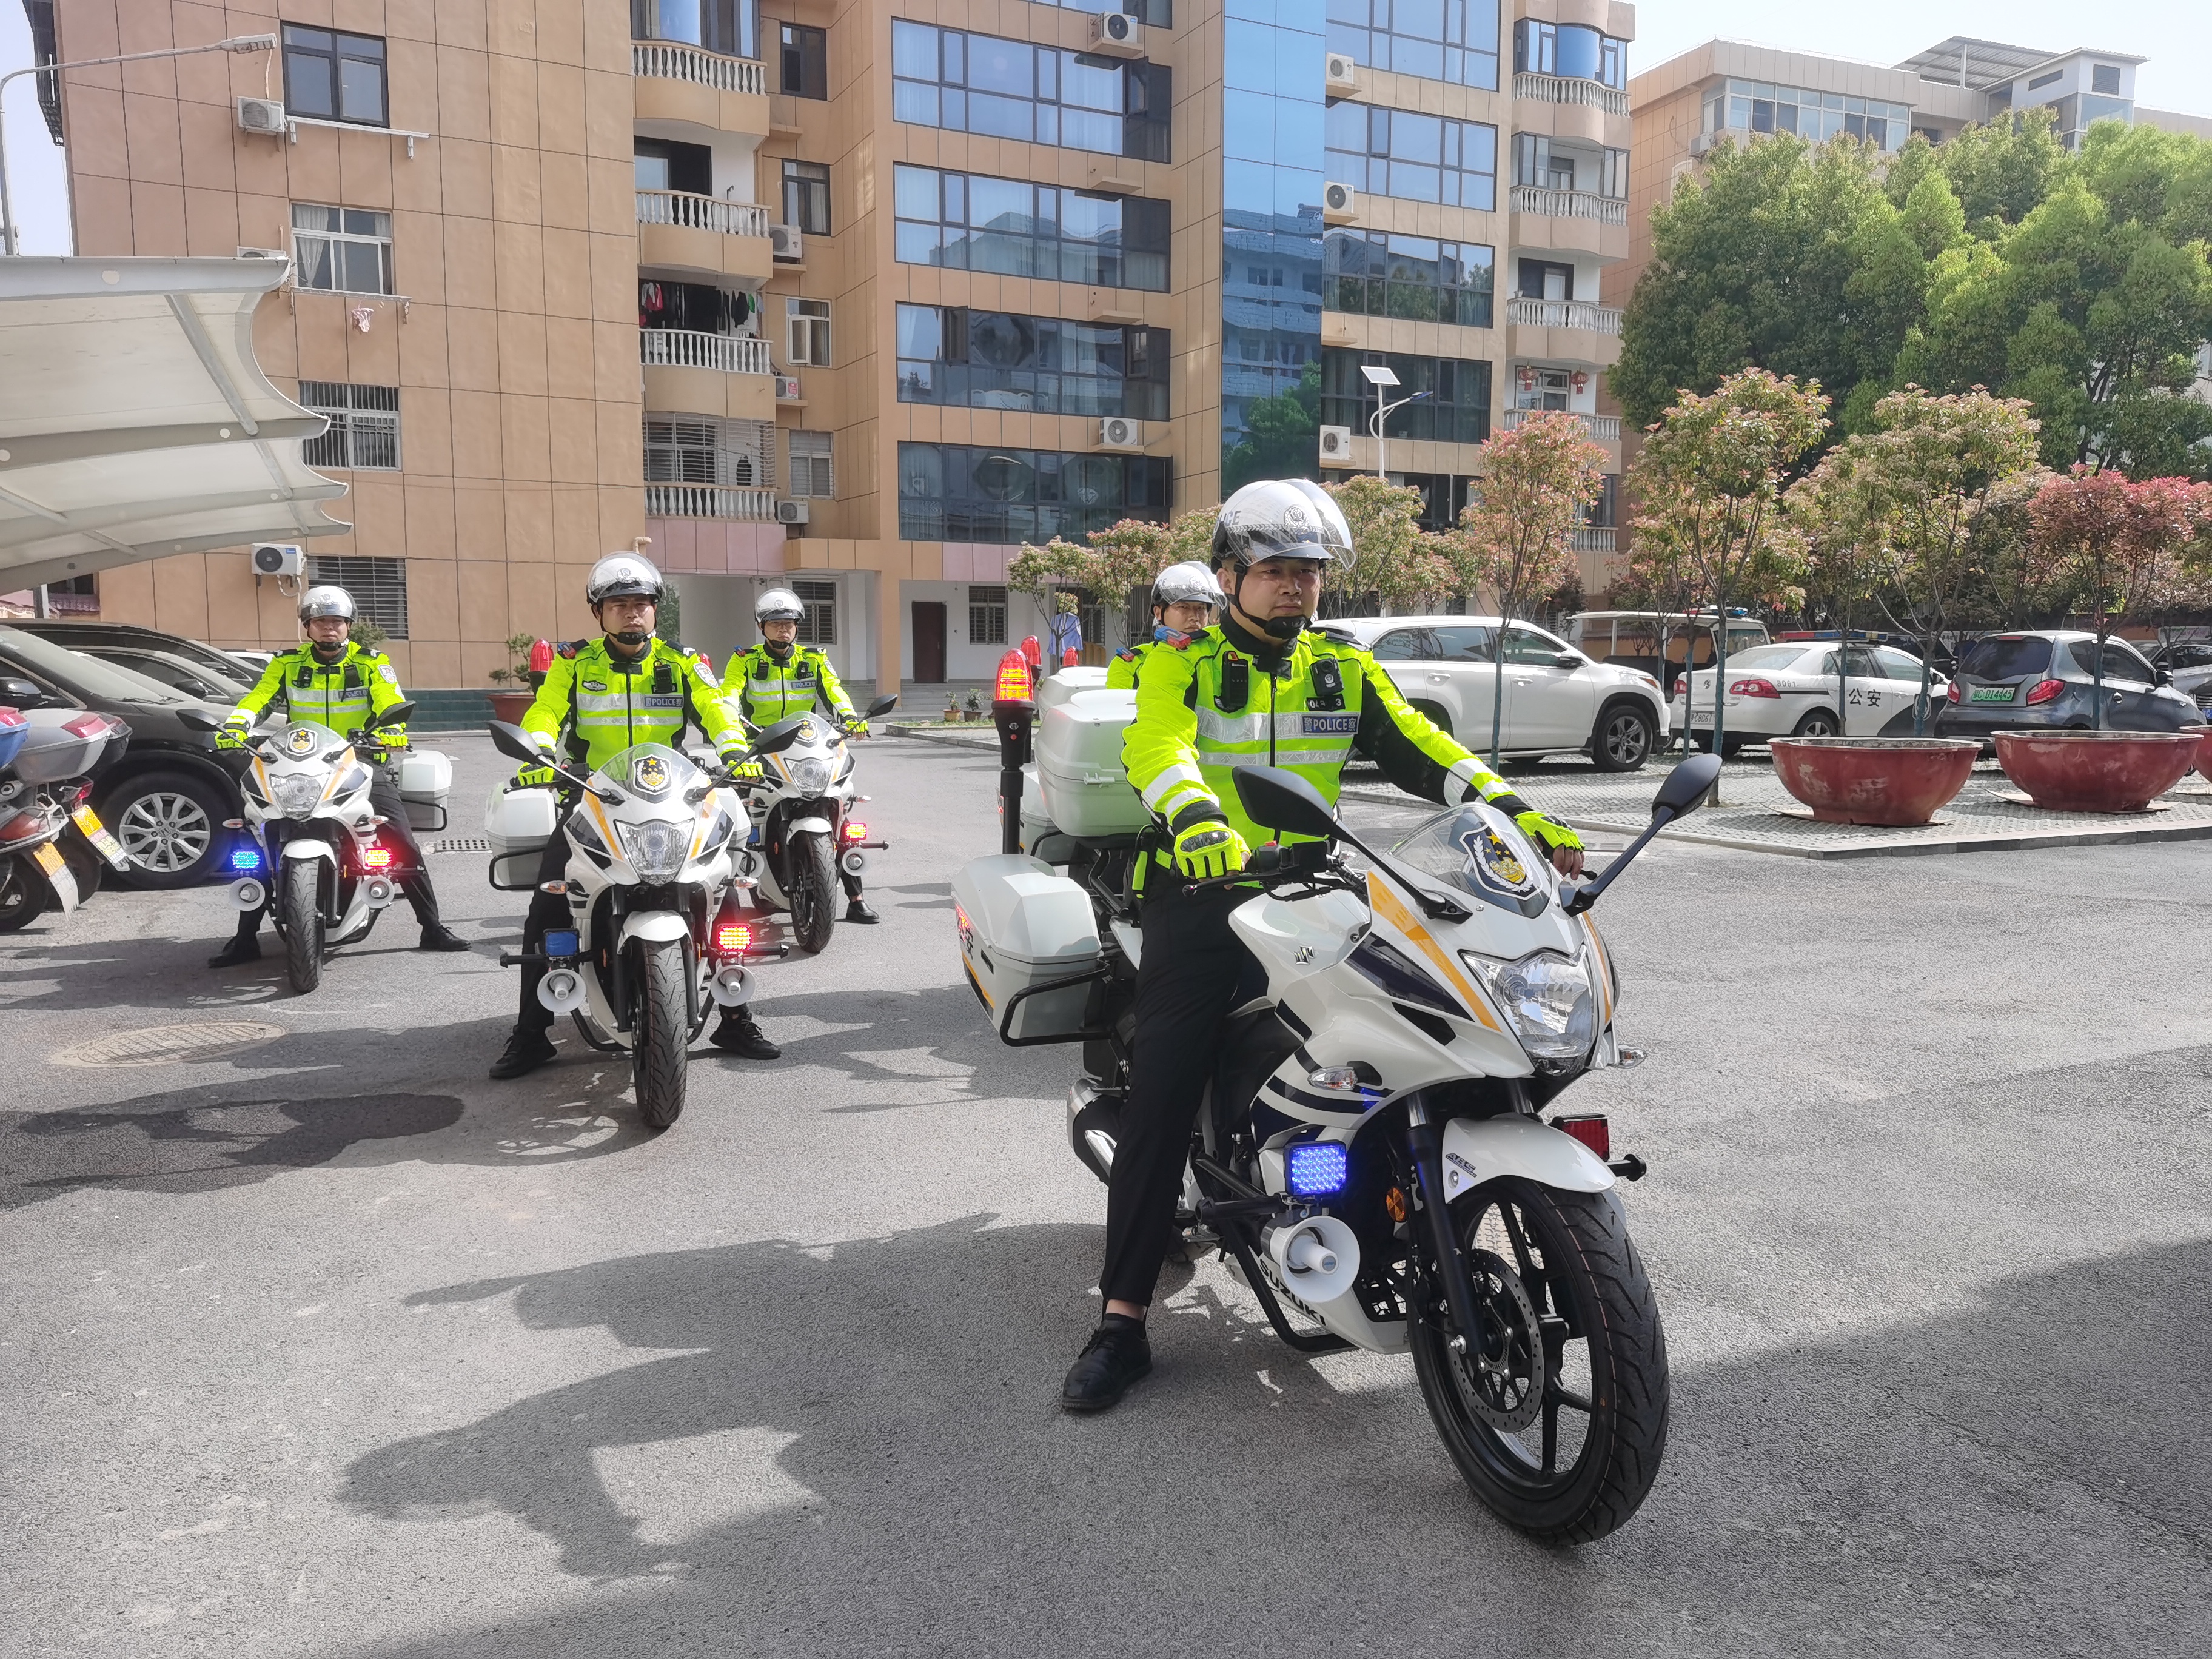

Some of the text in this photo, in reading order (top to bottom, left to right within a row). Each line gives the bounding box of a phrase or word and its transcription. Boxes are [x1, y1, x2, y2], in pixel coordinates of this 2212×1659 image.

[1848, 688, 1882, 707] 公安
[1446, 1153, 1475, 1173] ABS
[1259, 1258, 1327, 1327] SUZUKI
